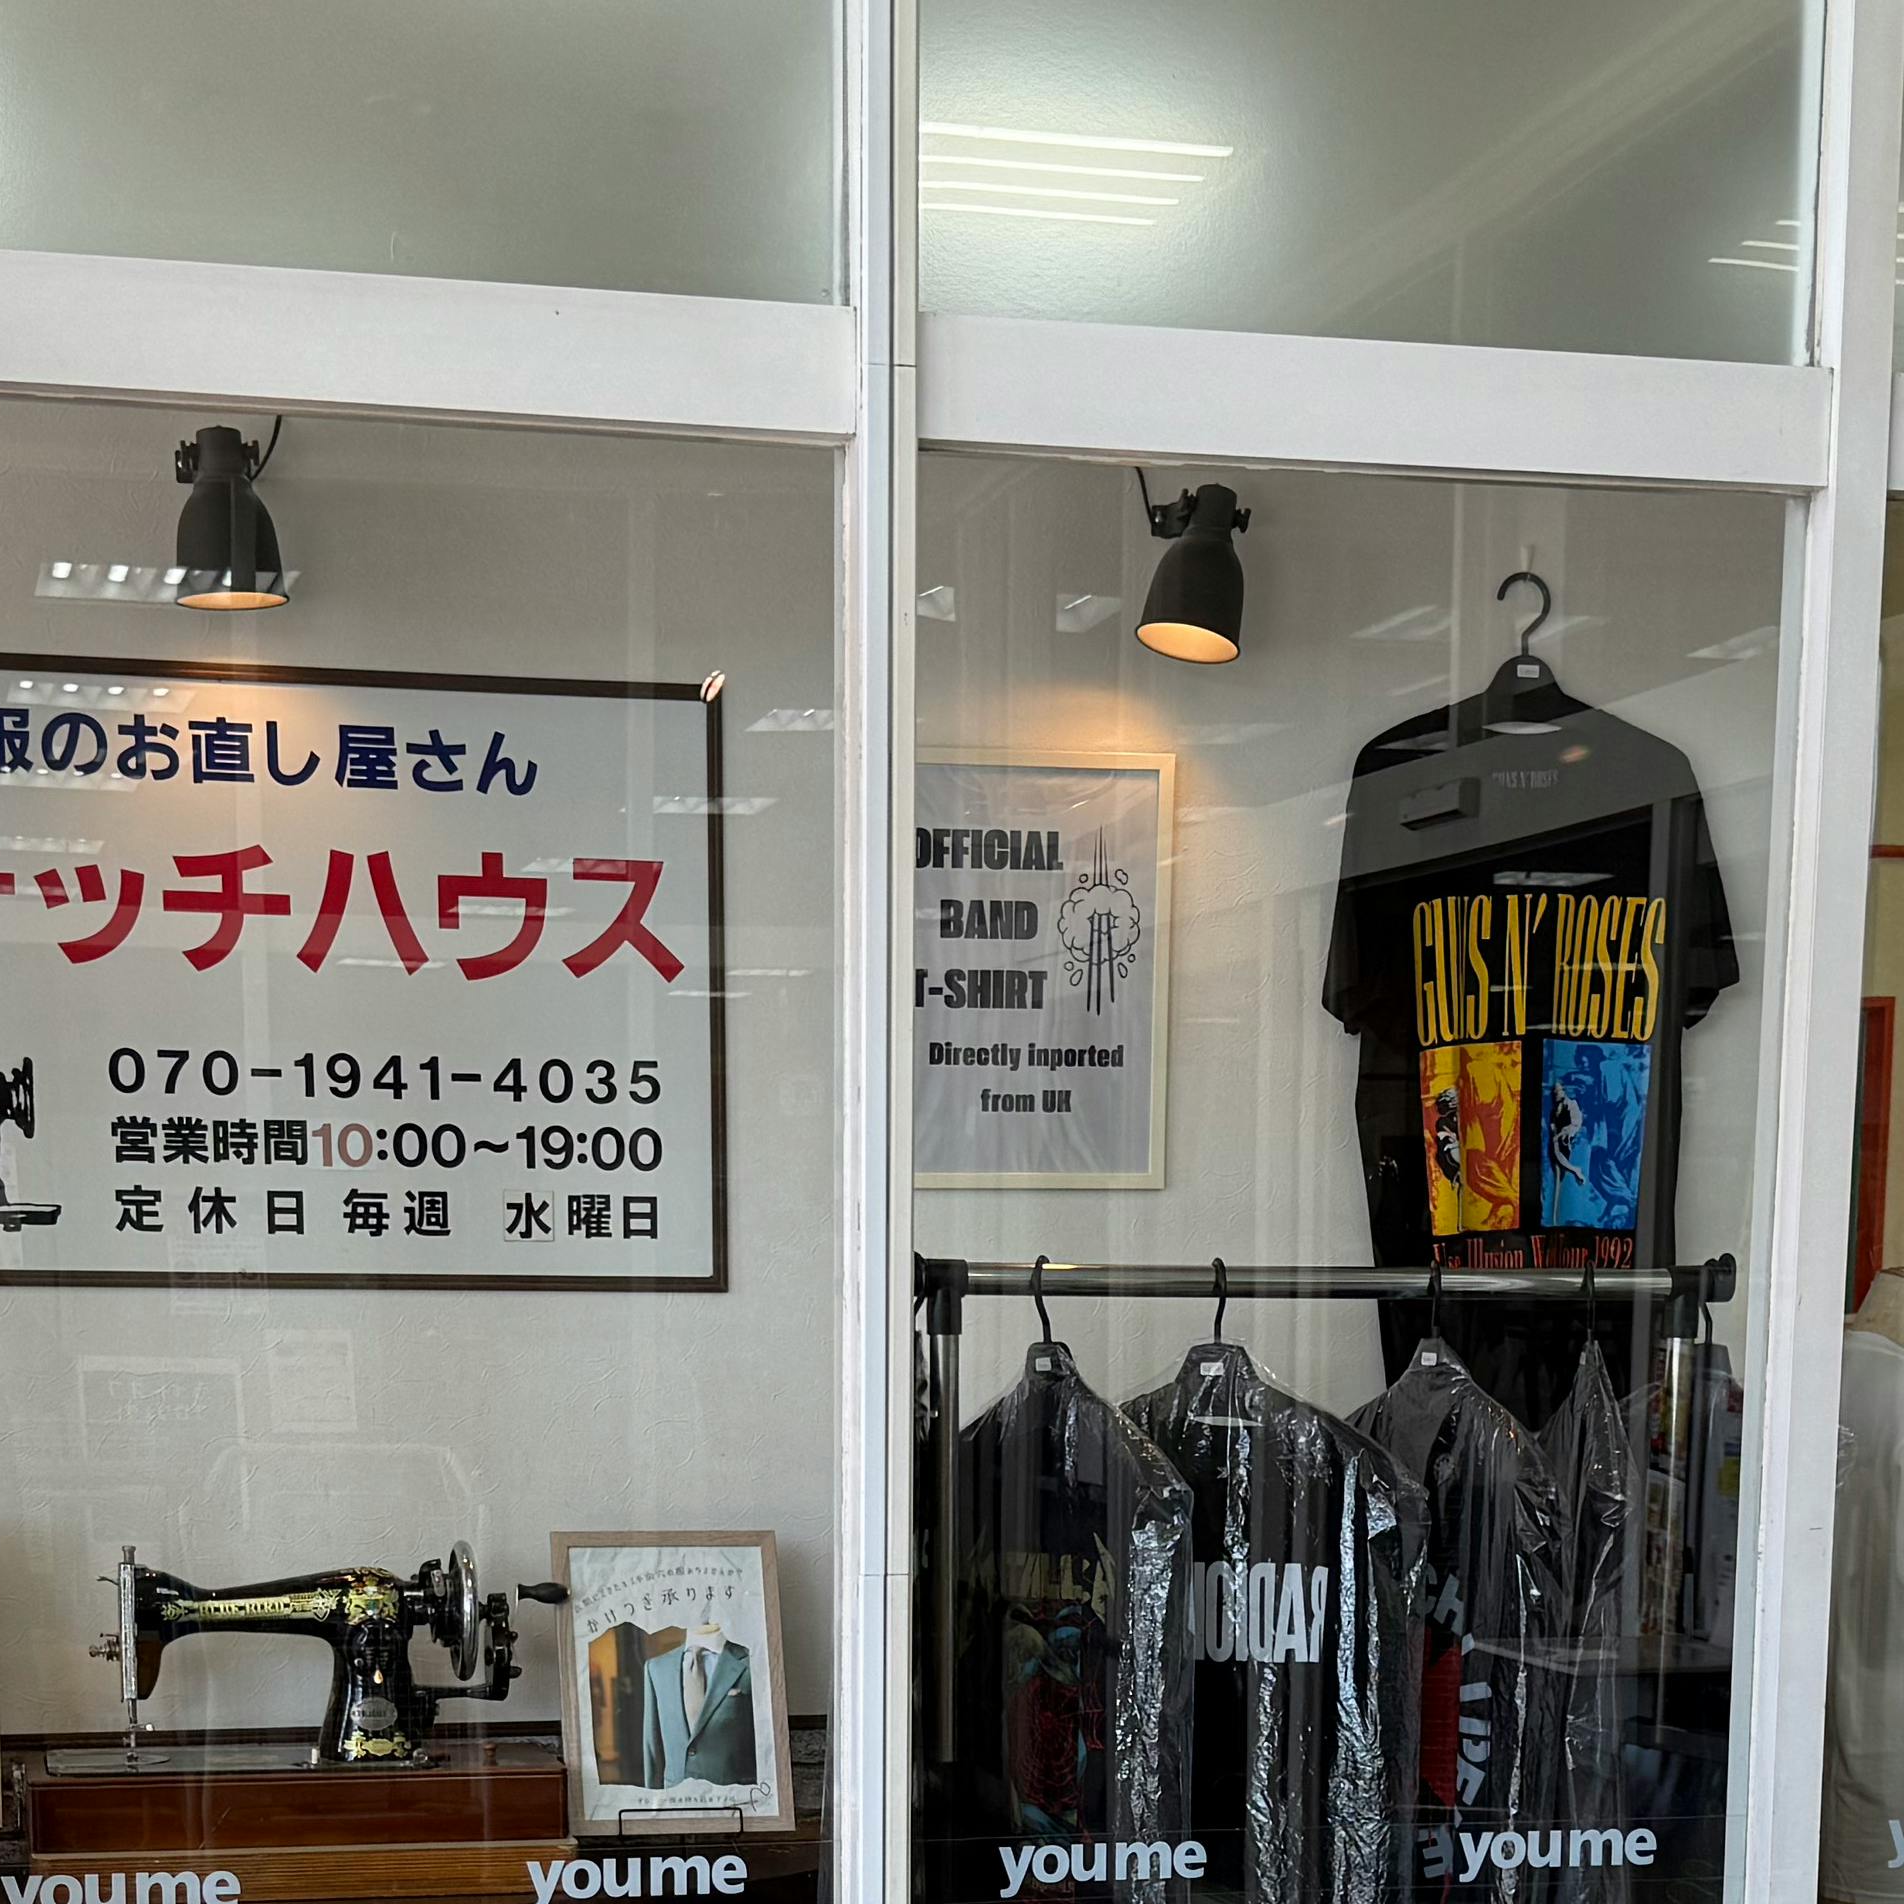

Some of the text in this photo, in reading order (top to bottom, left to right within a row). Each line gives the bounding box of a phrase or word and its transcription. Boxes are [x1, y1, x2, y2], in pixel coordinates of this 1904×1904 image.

[940, 900, 1038, 940] BAND
[915, 970, 1048, 1010] T-SHIRT
[1413, 894, 1494, 1046] GUNS
[1553, 894, 1667, 1041] ROSES
[108, 1047, 662, 1104] 070-1941-4035
[929, 1042, 1125, 1072] Directly inported
[980, 1088, 1072, 1114] from UK
[1595, 1236, 1634, 1269] 1992
[999, 1838, 1208, 1898] youme
[1459, 1828, 1658, 1883] youme
